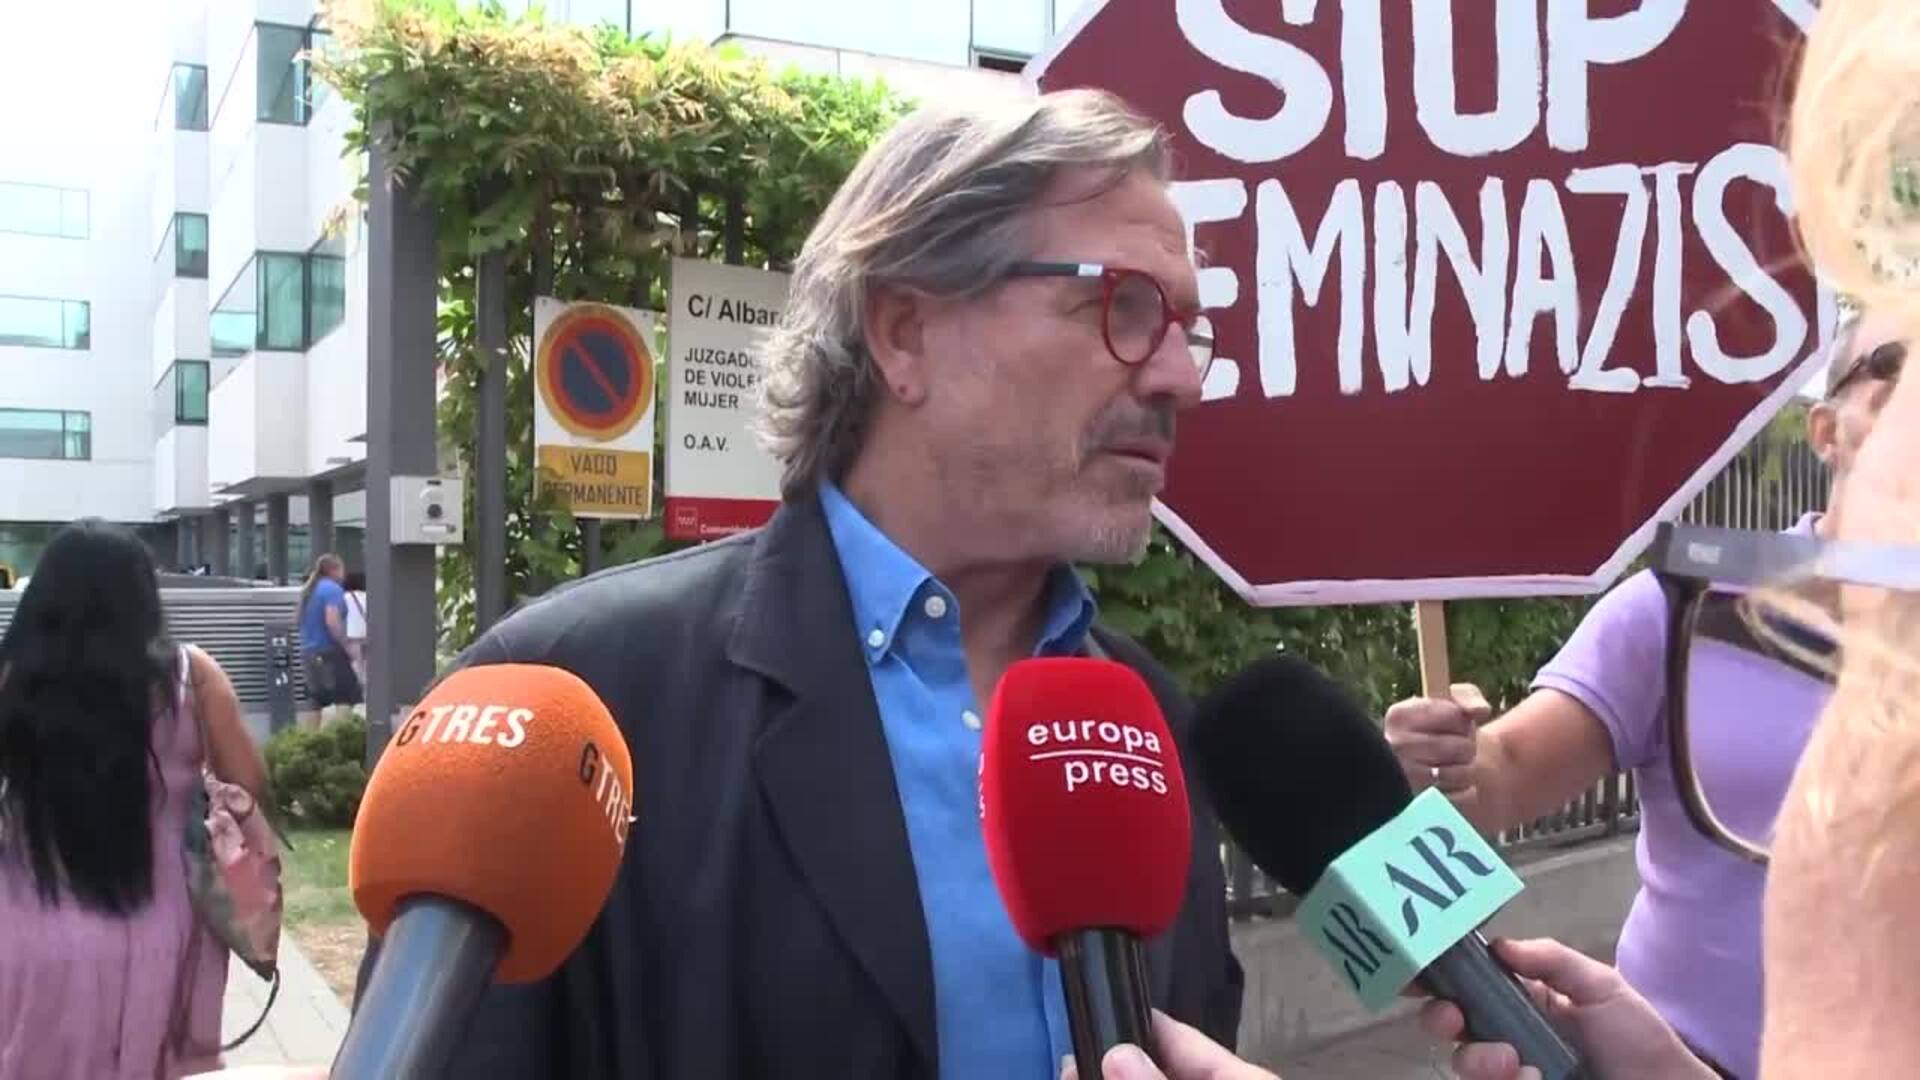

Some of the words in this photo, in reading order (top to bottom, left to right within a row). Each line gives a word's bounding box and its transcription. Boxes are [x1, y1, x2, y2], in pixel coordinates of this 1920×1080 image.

[1175, 0, 1687, 163] STOP
[688, 294, 712, 319] C/
[718, 299, 783, 326] Albar
[684, 369, 706, 385] DE
[710, 371, 762, 390] VIOLE
[684, 391, 739, 409] MUJER
[684, 433, 729, 452] O.A.V.
[570, 454, 618, 476] VADO
[396, 704, 535, 748] GTRES
[1027, 719, 1162, 754] europa
[1064, 760, 1167, 794] press
[579, 741, 638, 856] GTRE
[1384, 825, 1496, 937] AR
[1321, 902, 1393, 993] AR
